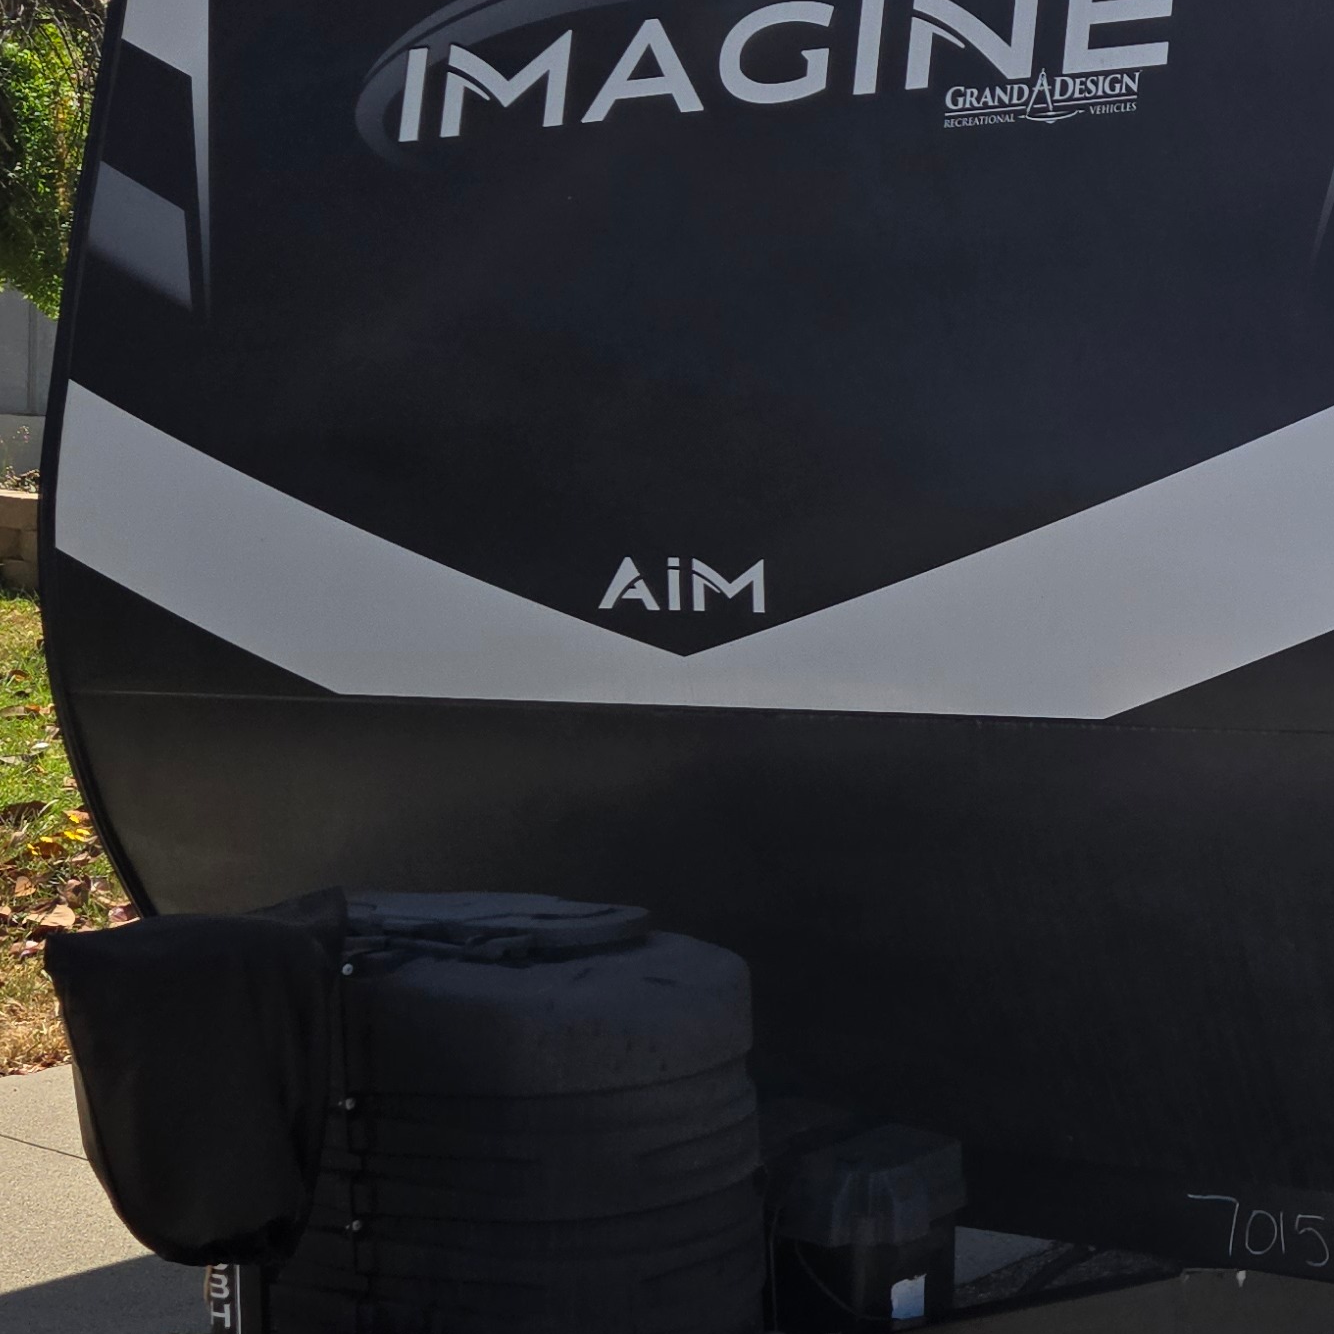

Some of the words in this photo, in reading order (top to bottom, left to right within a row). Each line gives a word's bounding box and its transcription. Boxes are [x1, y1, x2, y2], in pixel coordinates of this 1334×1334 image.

[945, 84, 1030, 110] GRAND
[1053, 71, 1140, 100] DESIGN
[944, 113, 1016, 128] RECREATIONAL
[1089, 102, 1138, 115] VEHICLES
